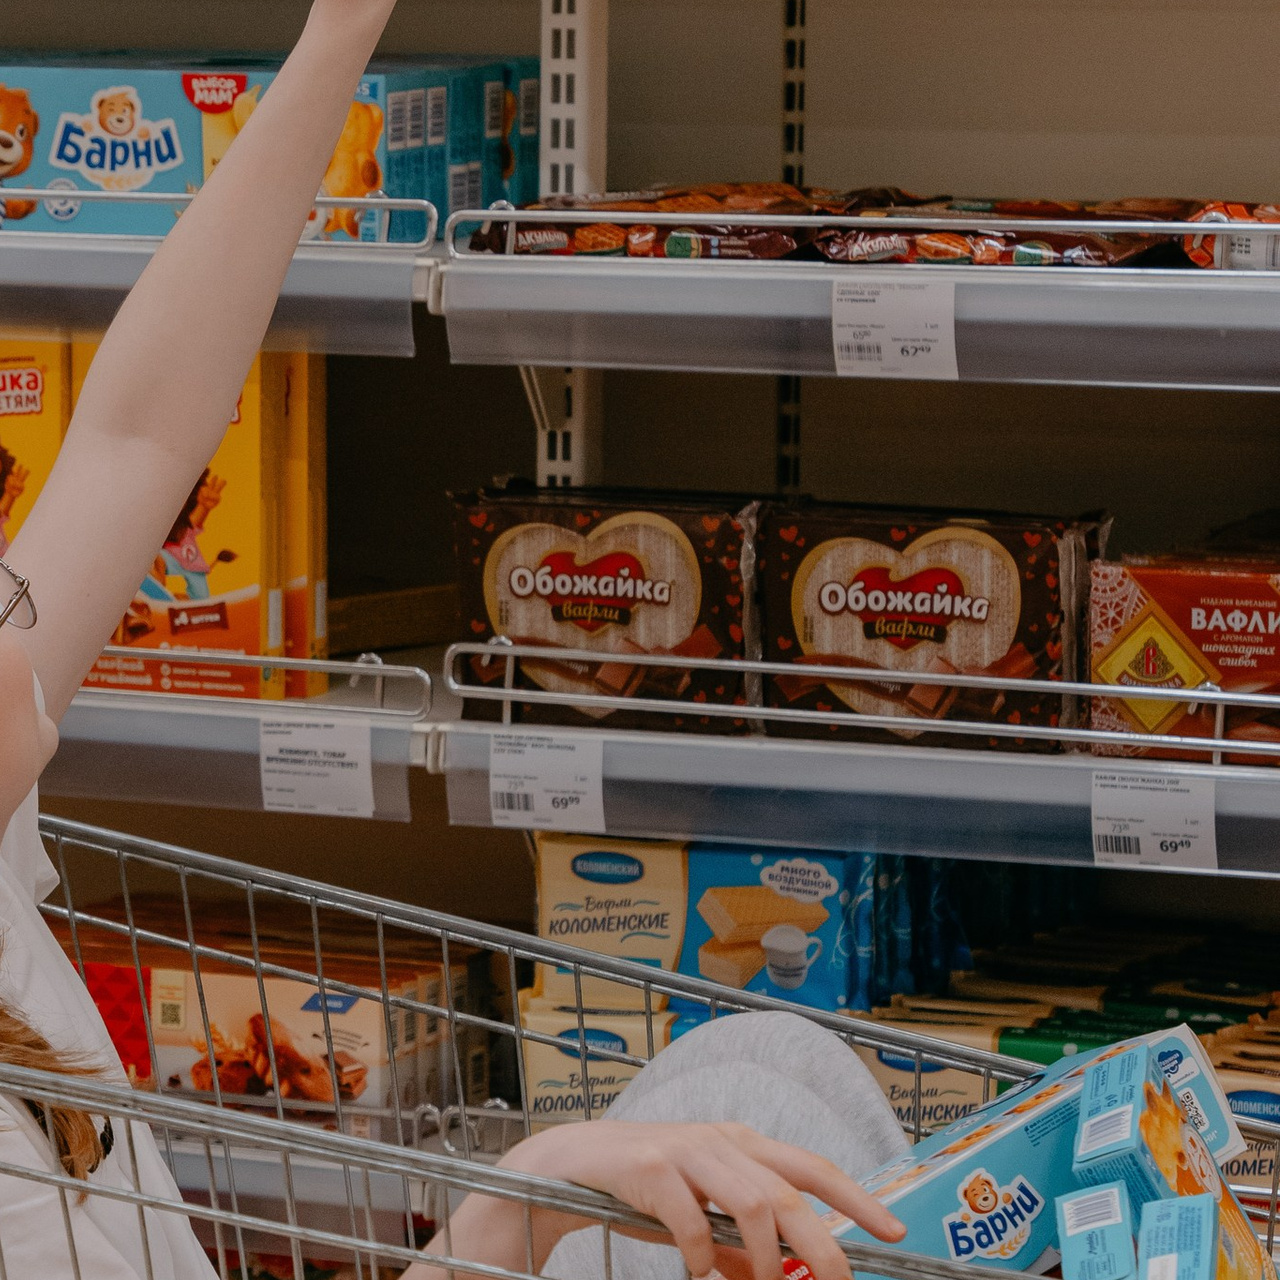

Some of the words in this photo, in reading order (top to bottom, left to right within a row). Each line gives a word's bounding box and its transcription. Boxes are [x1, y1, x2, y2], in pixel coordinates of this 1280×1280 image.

[57, 120, 175, 172] Барни
[510, 567, 671, 604] Обожайка
[561, 601, 621, 622] вафли
[821, 580, 990, 622] Обожайка
[874, 618, 936, 641] вафли
[1220, 634, 1264, 643] АРОМАТОМ
[1202, 643, 1276, 658] шоколадных
[1219, 656, 1258, 668] сливок
[780, 865, 821, 878] МНОГО
[549, 913, 670, 936] КОЛОМЕНСКИЕ
[948, 1181, 1040, 1257] Барни
